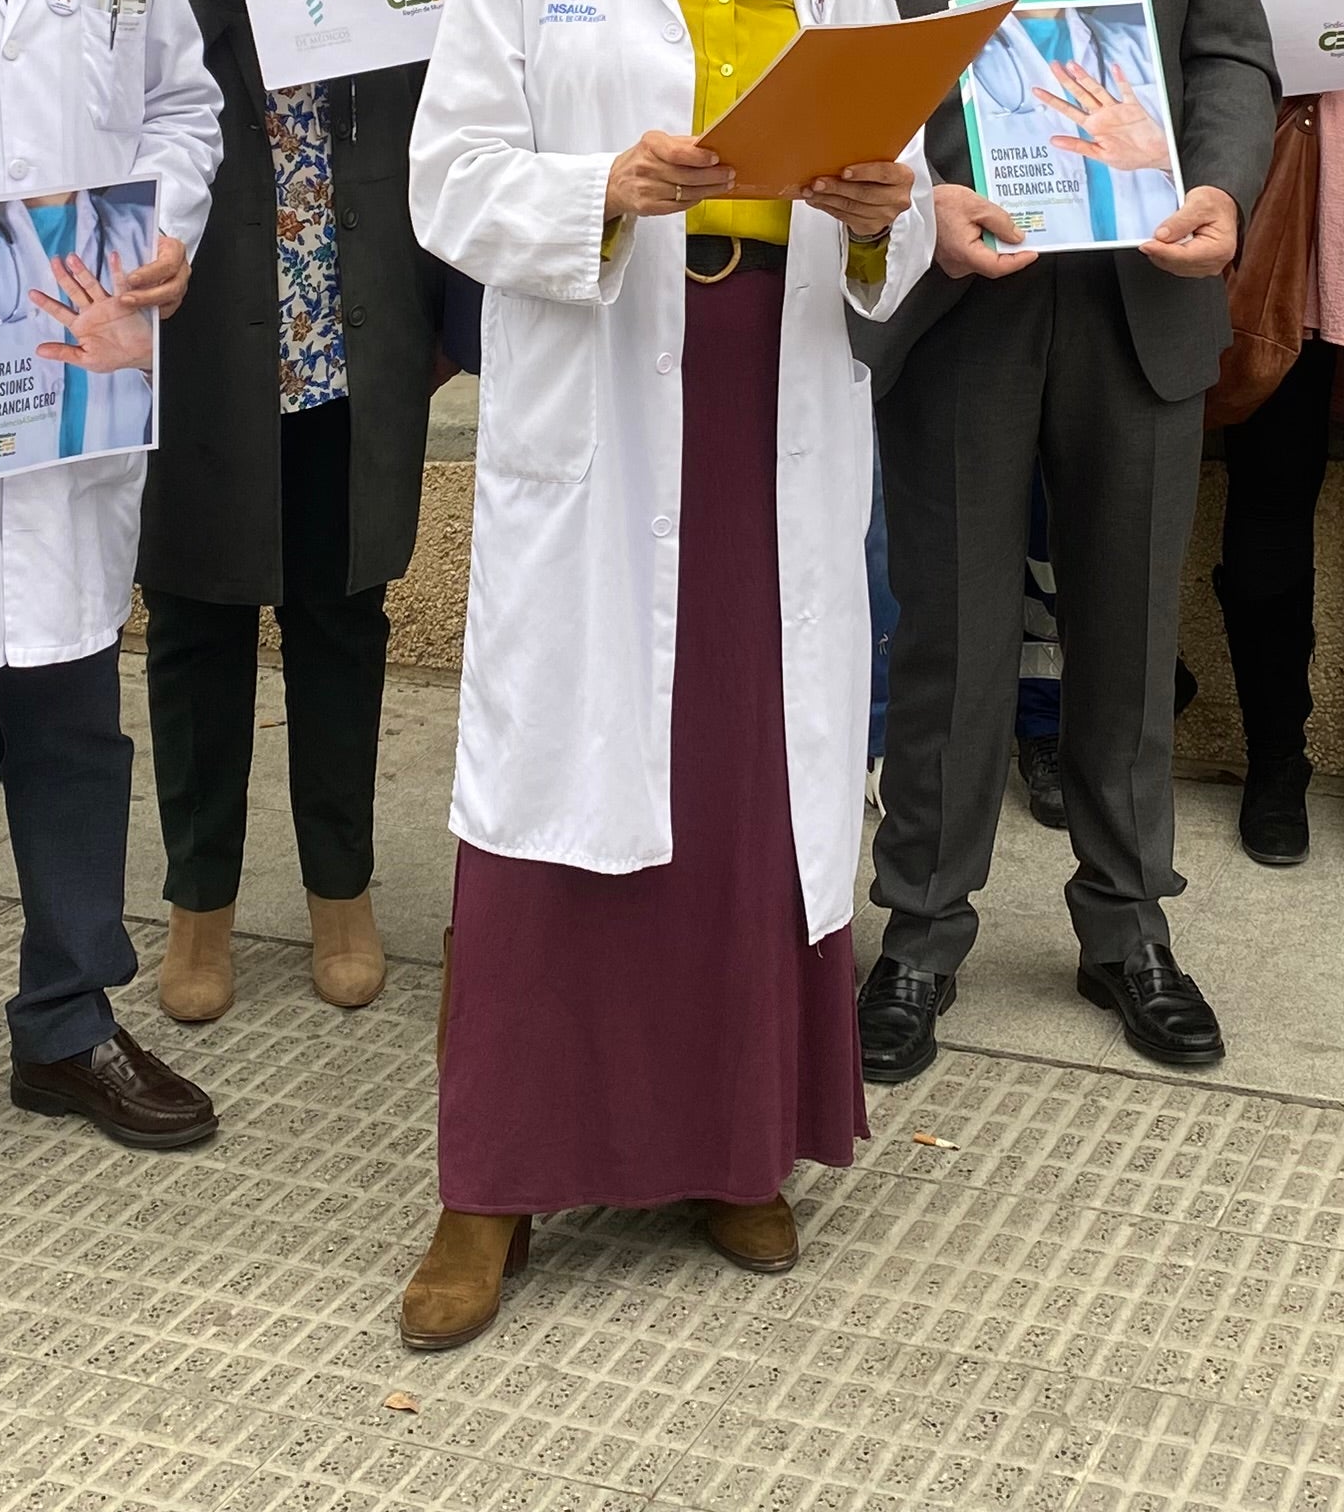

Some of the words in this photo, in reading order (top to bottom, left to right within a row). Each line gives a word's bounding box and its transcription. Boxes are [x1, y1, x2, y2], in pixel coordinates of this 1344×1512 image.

[547, 3, 597, 15] INSALUD
[991, 147, 1028, 161] CONTRA
[1030, 146, 1048, 159] LAS
[994, 163, 1054, 179] AGRESIONES
[996, 181, 1054, 197] TOLERANCIA
[1056, 180, 1080, 193] CERO
[14, 357, 32, 374] LAS
[33, 391, 56, 409] CERO
